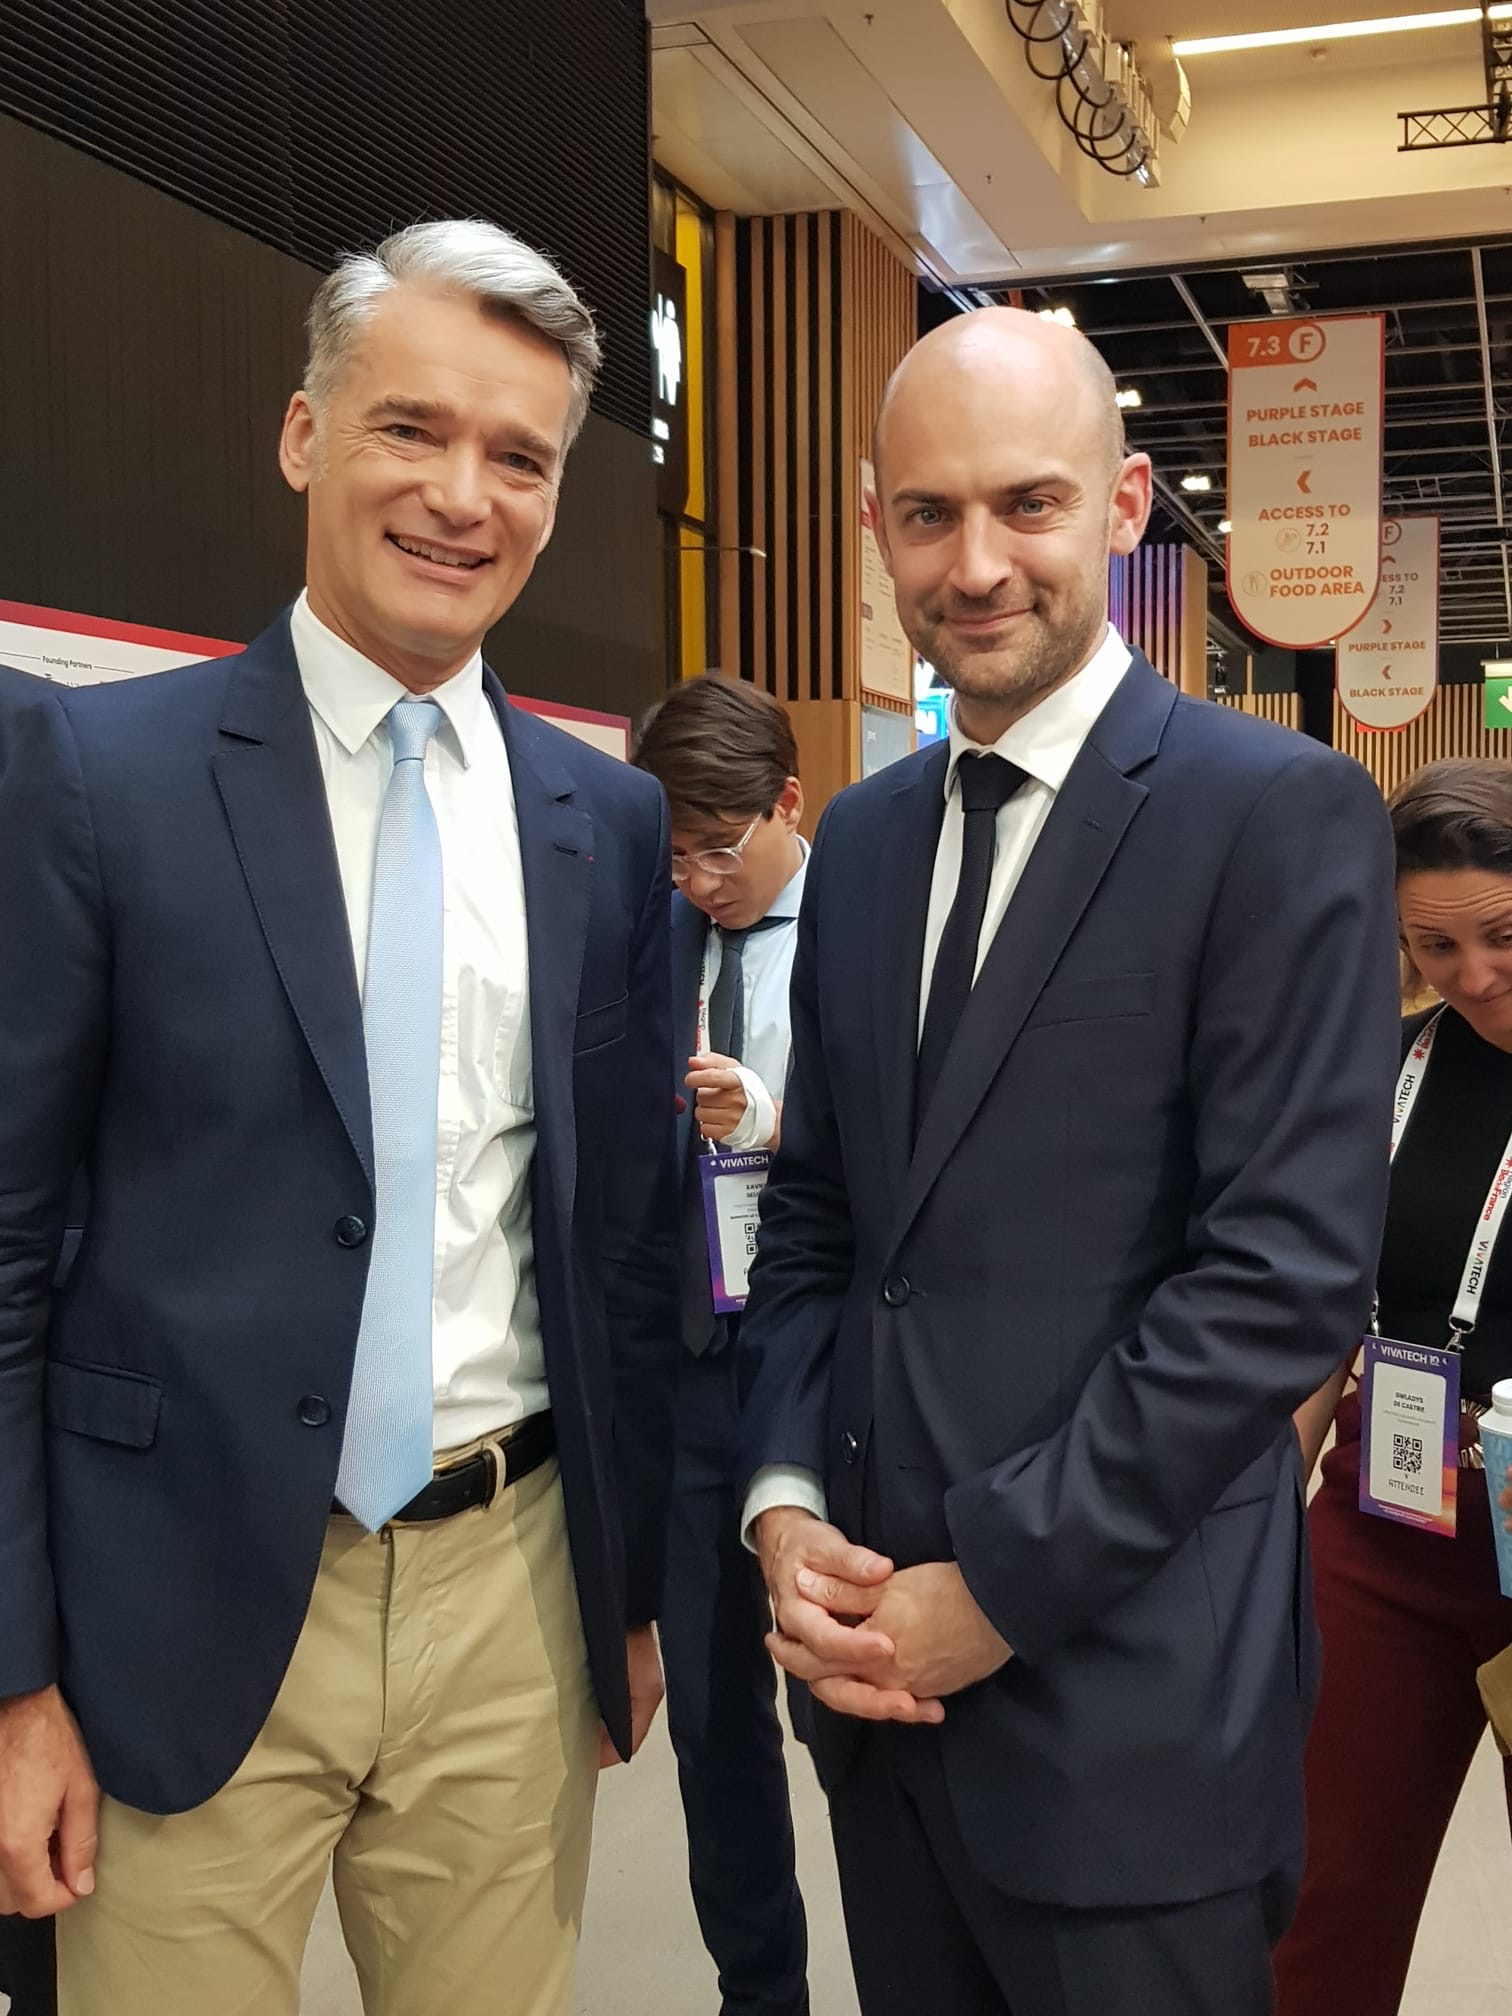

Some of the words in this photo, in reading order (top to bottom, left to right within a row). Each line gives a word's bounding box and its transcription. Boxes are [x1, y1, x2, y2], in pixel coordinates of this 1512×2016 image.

[1247, 335, 1281, 357] 7.3
[1299, 332, 1314, 353] F
[1246, 406, 1306, 421] PURPLE
[1310, 402, 1364, 418] STAGE
[1248, 432, 1303, 448] BLACK
[1307, 428, 1362, 443] STAGE
[1258, 506, 1325, 521] ACCESS
[1328, 504, 1351, 517] TO
[1306, 523, 1329, 537] 7.2
[1306, 541, 1326, 555] 7.1
[1270, 565, 1354, 581] OUTDOOR
[1404, 573, 1419, 581] TO
[1270, 584, 1317, 598] FOOD
[1320, 581, 1365, 595] AREA
[1389, 585, 1405, 594] 7.2
[1389, 596, 1402, 605] 7.1
[1348, 642, 1389, 652] PURPLE
[1390, 640, 1426, 651] STAGE
[1349, 688, 1386, 698] BLACK
[1388, 686, 1424, 697] STAGE
[1392, 1074, 1416, 1124] VIVATECH
[719, 1155, 769, 1169] VIVATECH
[1466, 1240, 1489, 1295] VIVATECH
[1380, 1345, 1427, 1364] VIVATECH
[1388, 1478, 1425, 1496] ATTENDEE
